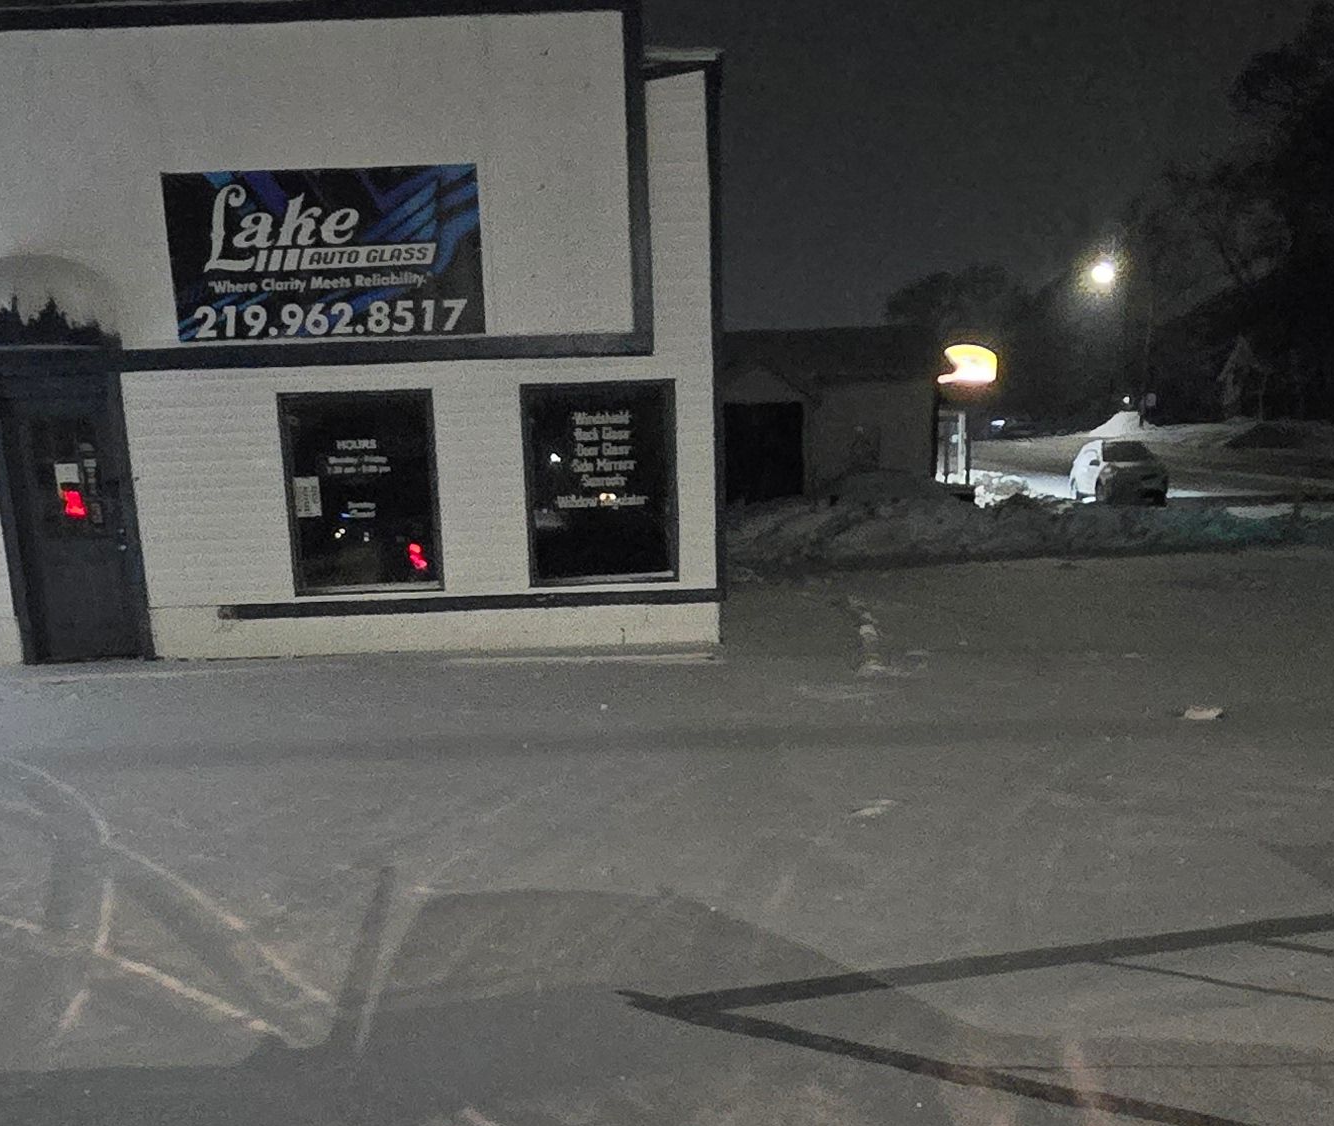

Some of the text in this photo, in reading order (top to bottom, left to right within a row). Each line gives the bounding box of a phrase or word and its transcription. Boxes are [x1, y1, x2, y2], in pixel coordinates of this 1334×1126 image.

[203, 184, 360, 273] Lake
[309, 246, 430, 266] AUTO GLASS
[261, 278, 306, 293] Clarity
[310, 276, 352, 290] Meets
[193, 298, 468, 339] 219.962.8517
